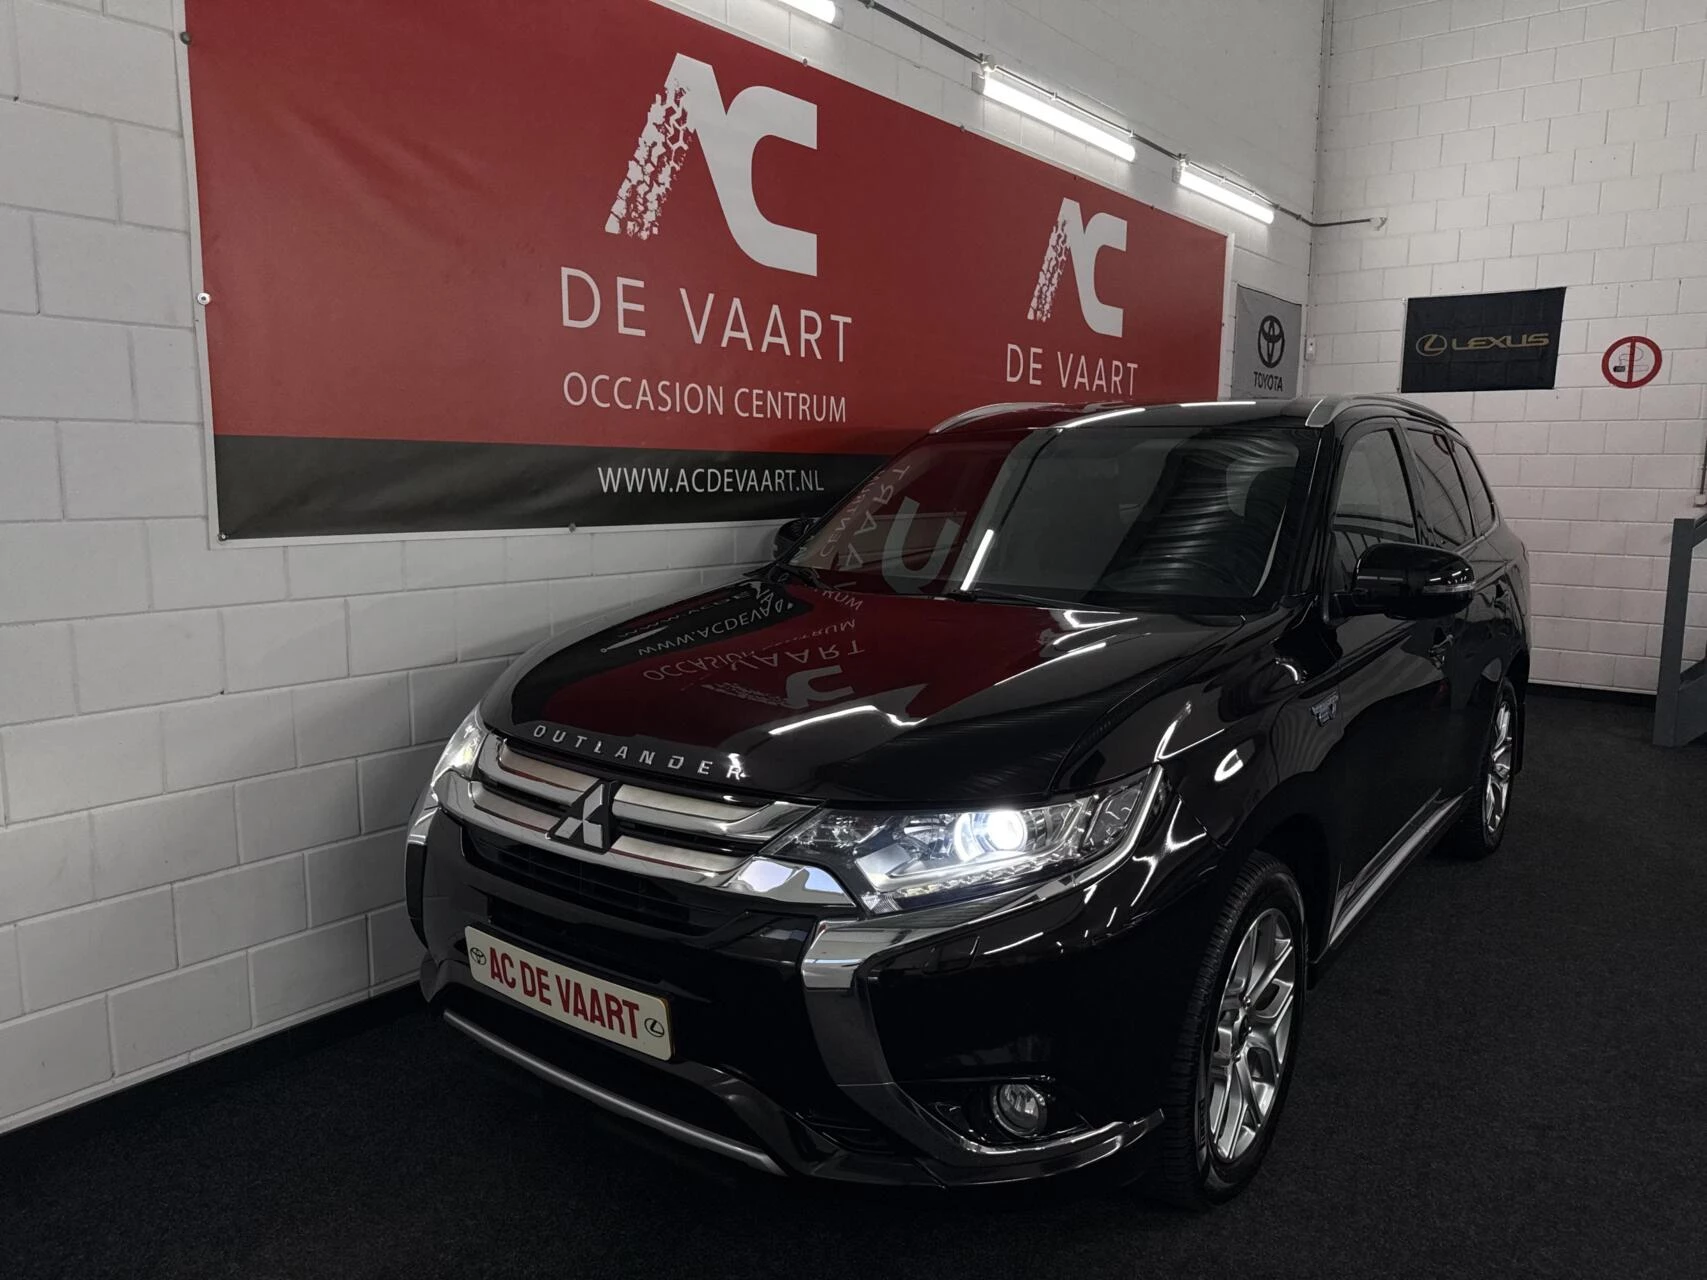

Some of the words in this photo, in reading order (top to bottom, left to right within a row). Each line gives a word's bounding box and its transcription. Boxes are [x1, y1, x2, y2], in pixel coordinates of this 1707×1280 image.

[561, 266, 646, 337] DE
[679, 287, 852, 363] VAART
[1452, 333, 1550, 350] LEXUS
[1006, 343, 1043, 386] DE
[1057, 351, 1139, 396] VAART
[1253, 370, 1284, 393] TOYOTA
[563, 371, 724, 416] OCCASION
[734, 387, 846, 423] CENTRUM
[598, 466, 825, 493] WWW.ACDEVAART.NL
[533, 724, 745, 780] OUTLANDER
[489, 947, 516, 989] AC
[519, 959, 552, 1007] DE
[555, 974, 640, 1039] VAART
